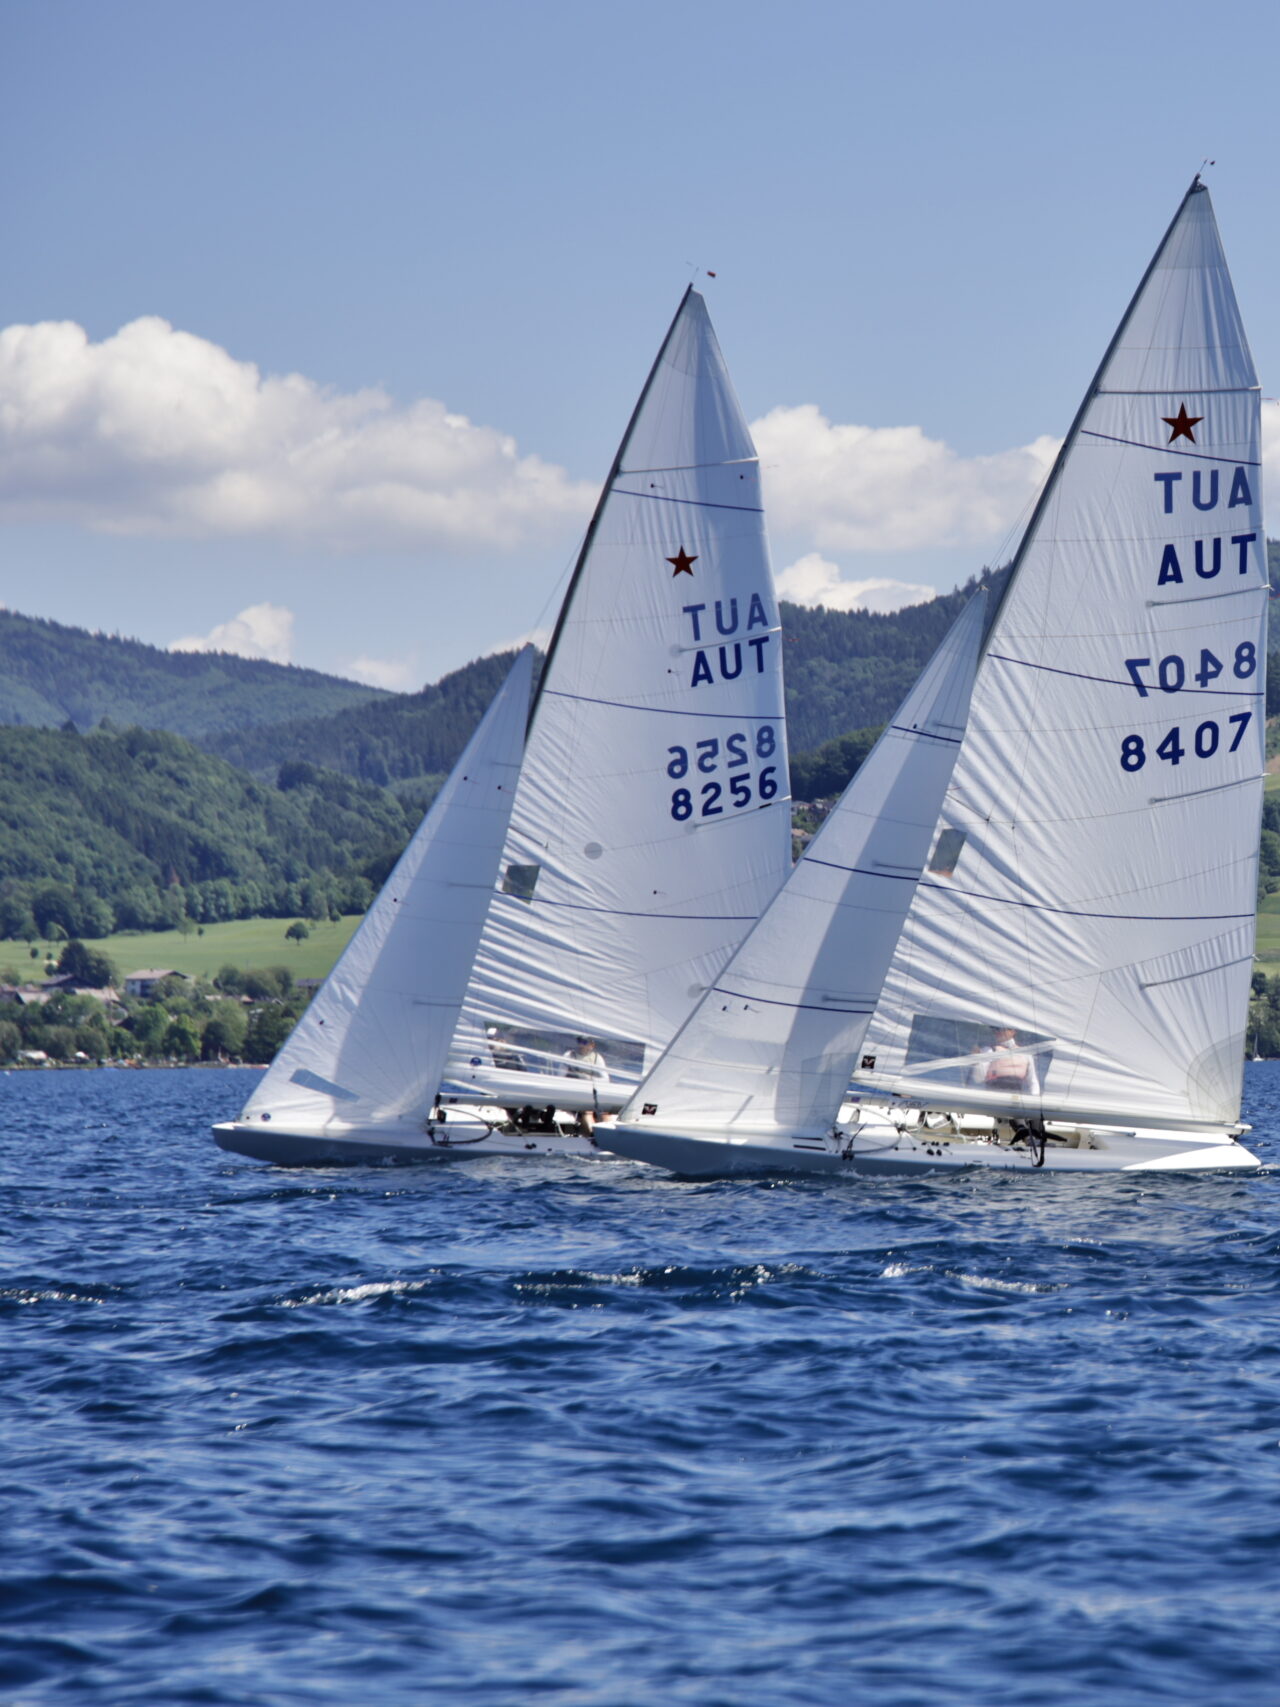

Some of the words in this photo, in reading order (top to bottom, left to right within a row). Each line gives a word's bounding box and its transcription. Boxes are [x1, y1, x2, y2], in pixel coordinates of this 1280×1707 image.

[1157, 533, 1257, 586] AUT
[690, 636, 770, 688] AUT
[1120, 711, 1253, 772] 8407
[670, 766, 778, 821] 8256
